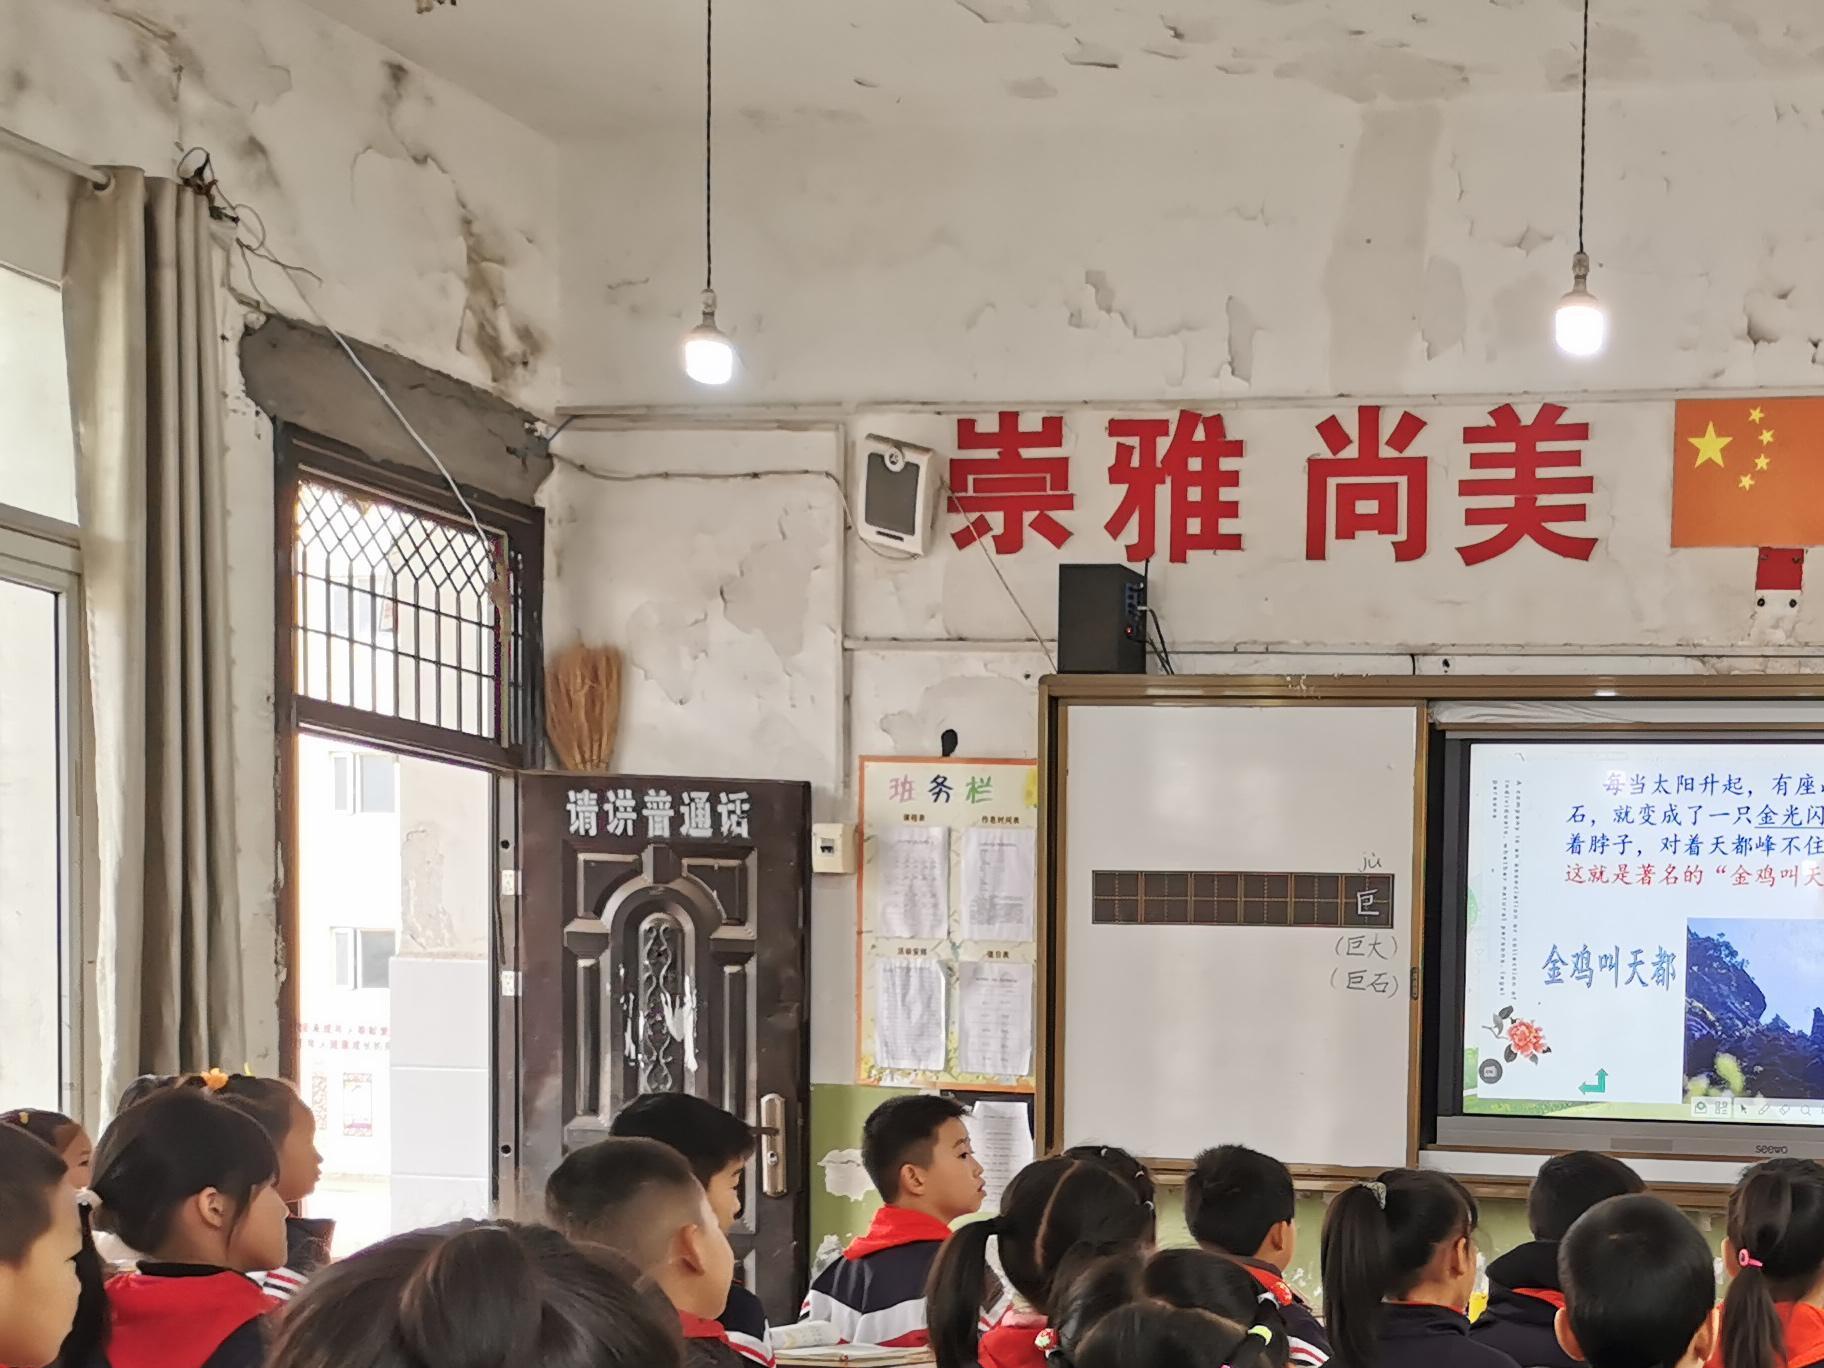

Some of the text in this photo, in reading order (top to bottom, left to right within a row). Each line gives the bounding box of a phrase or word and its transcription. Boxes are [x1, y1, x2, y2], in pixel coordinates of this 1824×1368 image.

[945, 402, 1600, 566] 崇雅 尚美
[889, 774, 994, 805] 班务栏
[566, 788, 751, 839] 请讲普通话
[1357, 888, 1380, 916] 巨
[1542, 943, 1677, 991] 金鸡叫天都
[1755, 1144, 1788, 1154] seewo
